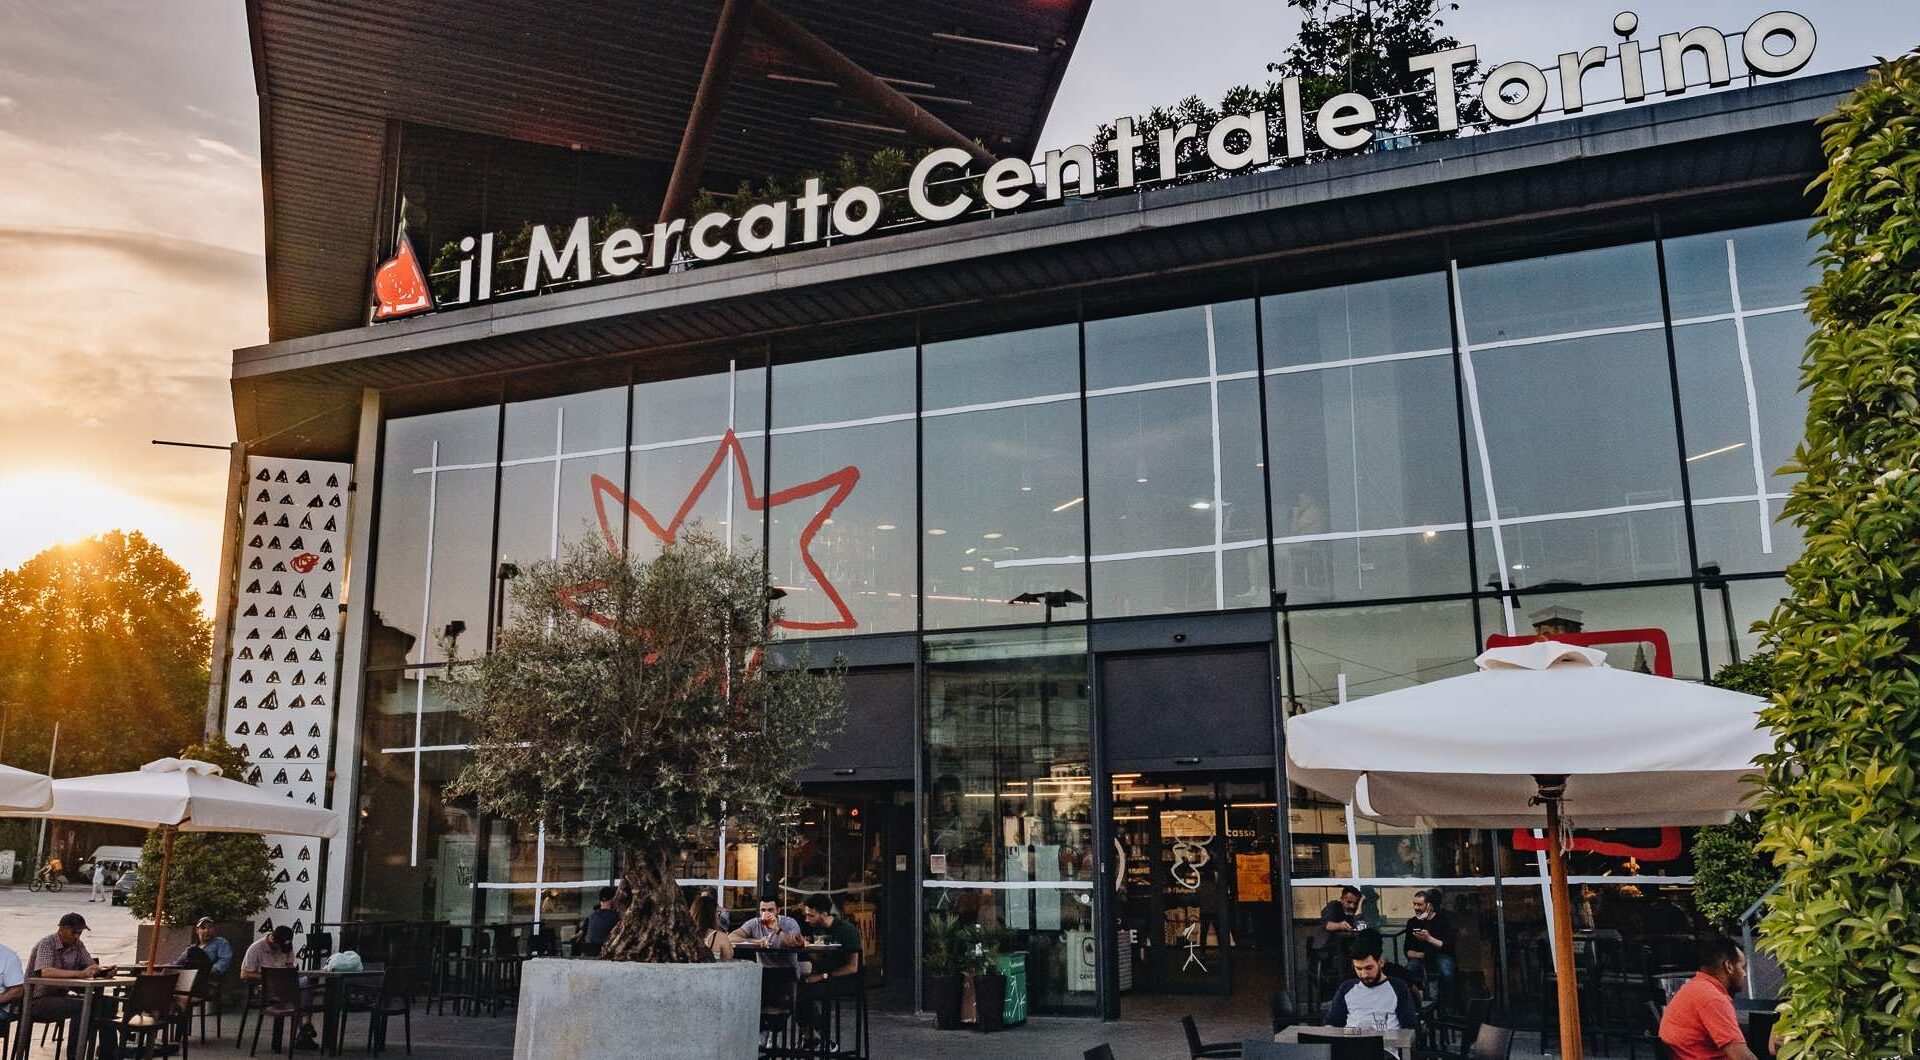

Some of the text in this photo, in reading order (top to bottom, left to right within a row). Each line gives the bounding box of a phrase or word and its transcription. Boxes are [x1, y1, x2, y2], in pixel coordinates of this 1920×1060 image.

[457, 9, 1818, 303] il Mercato Centrale Torino
